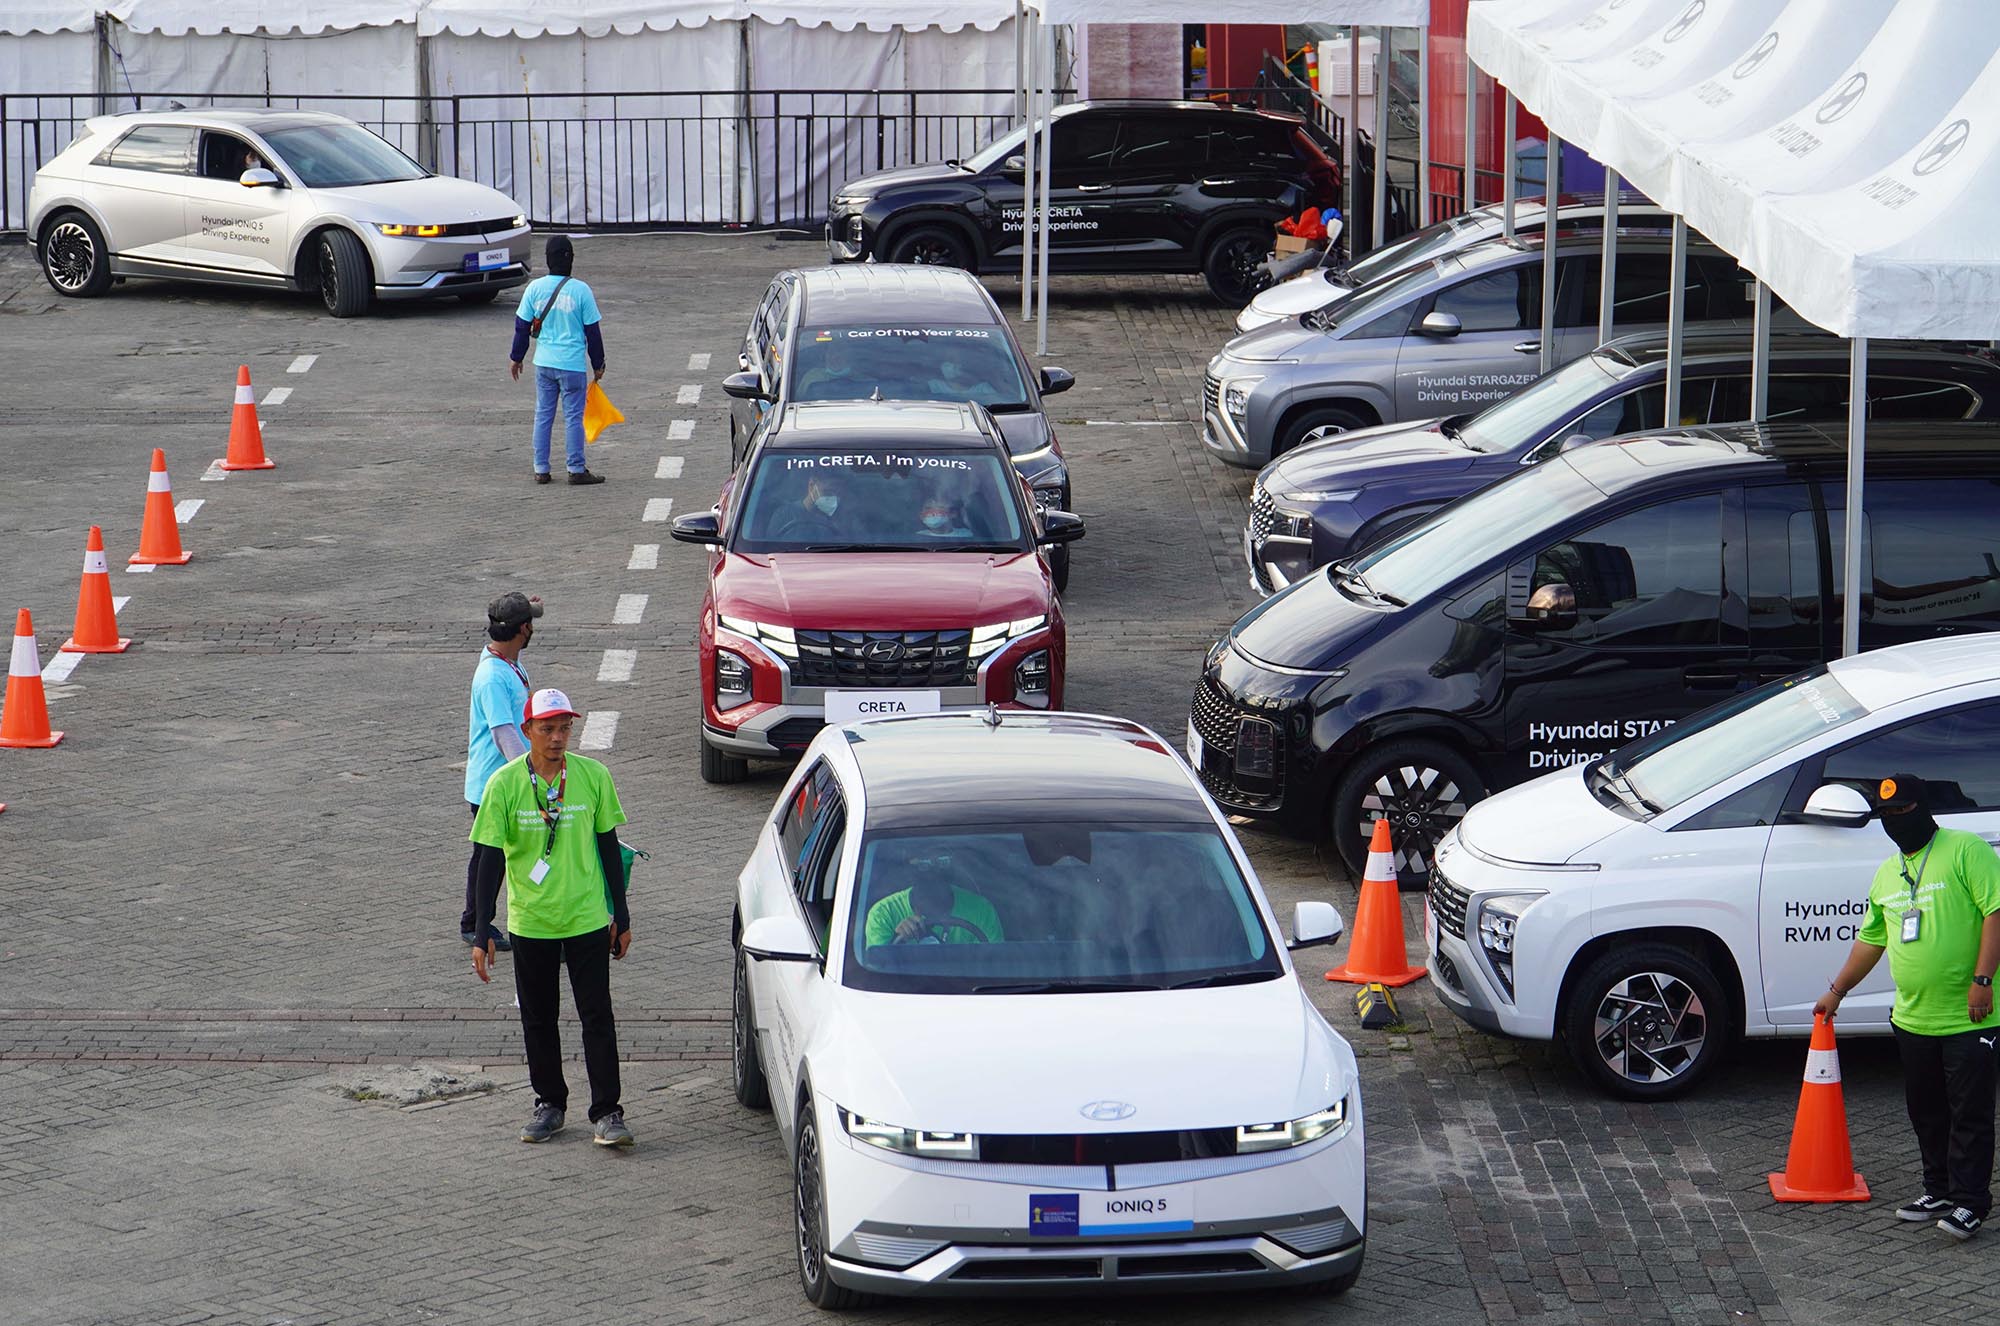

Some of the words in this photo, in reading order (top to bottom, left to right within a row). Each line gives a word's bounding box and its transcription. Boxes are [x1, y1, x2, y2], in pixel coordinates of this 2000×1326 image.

[1048, 207, 1083, 217] CRETA
[202, 216, 234, 226] Hyundai
[235, 219, 258, 231] IONIQ
[259, 222, 264, 231] 5
[1048, 220, 1098, 231] xperience
[202, 228, 228, 240] Driving
[229, 231, 270, 244] Experience
[848, 330, 873, 338] Car
[875, 329, 892, 337] Of
[893, 329, 920, 337] The
[922, 329, 952, 337] Year
[955, 329, 989, 338] 2022
[1418, 376, 1466, 388] Hyundai
[1418, 390, 1459, 402] Driving
[787, 458, 814, 470] I'm
[819, 455, 880, 467] CRETA.
[886, 455, 914, 466] I'm
[918, 457, 972, 470] yours.
[858, 701, 906, 713] CRETA
[1529, 720, 1618, 744] Hyundai
[1623, 720, 1676, 739] STA
[1785, 899, 1869, 921] Hyundai
[1785, 926, 1831, 943] RVM
[1107, 1200, 1153, 1213] IONIQ
[1157, 1198, 1167, 1211] 5
